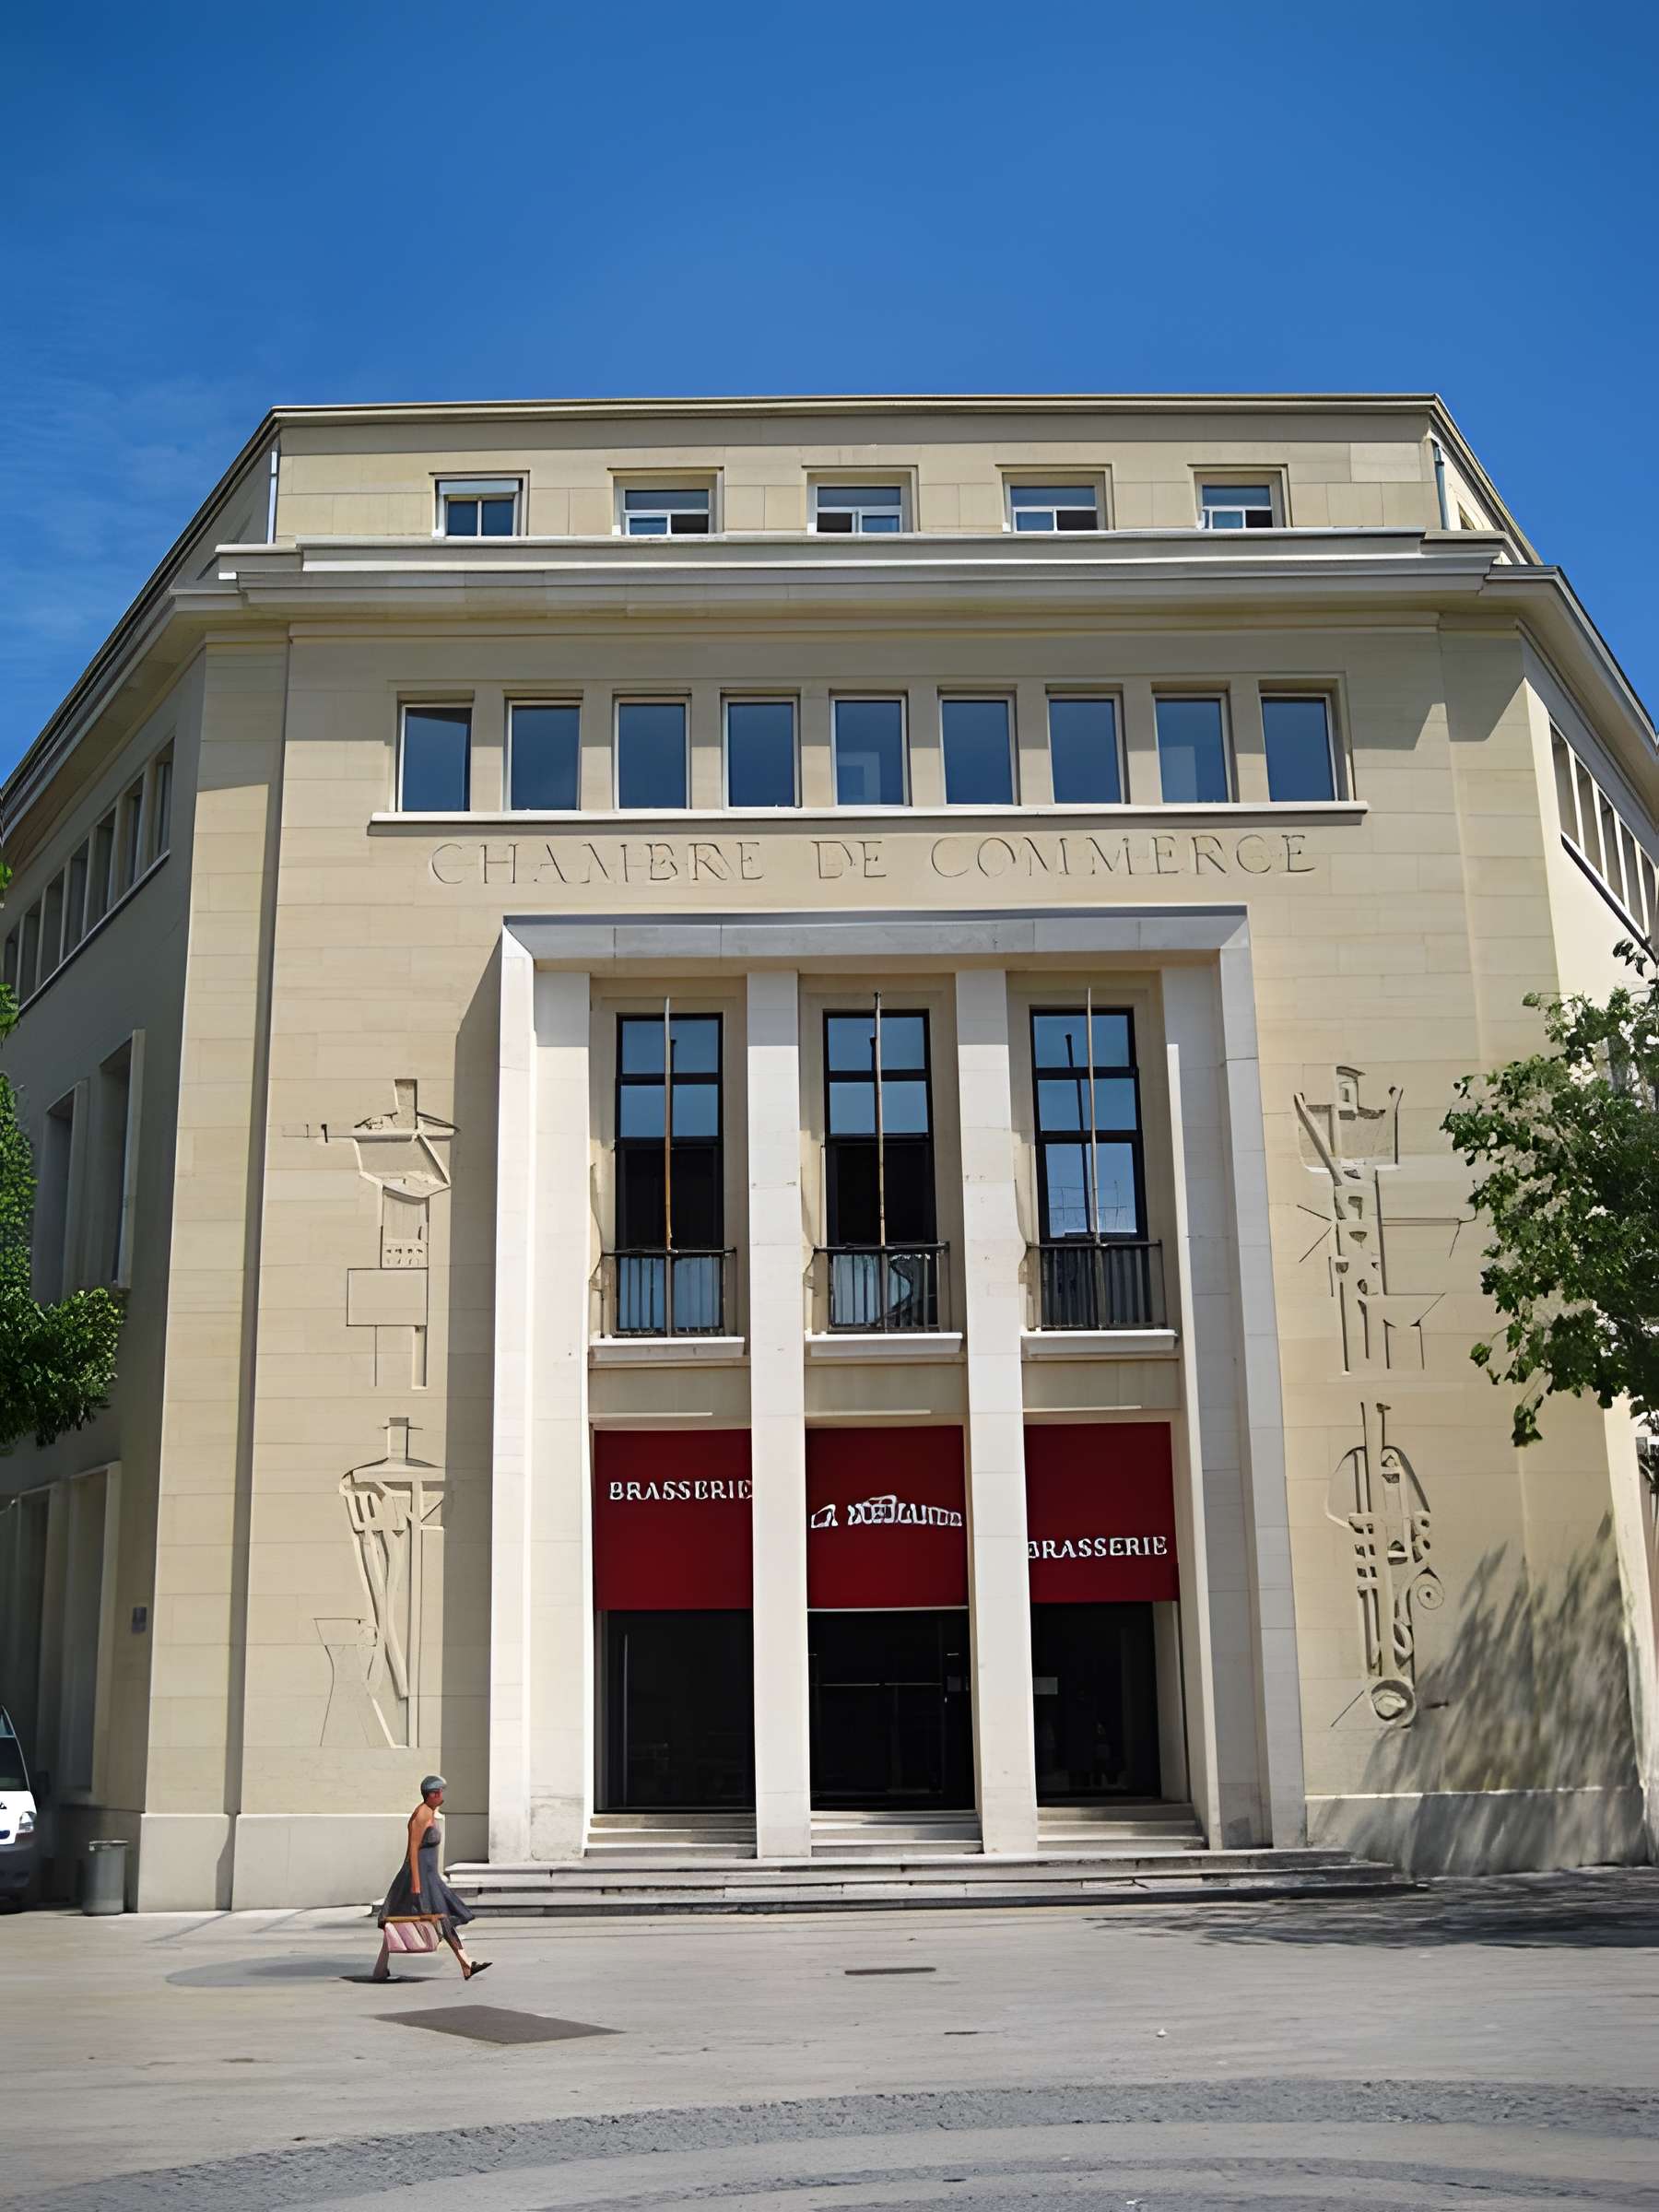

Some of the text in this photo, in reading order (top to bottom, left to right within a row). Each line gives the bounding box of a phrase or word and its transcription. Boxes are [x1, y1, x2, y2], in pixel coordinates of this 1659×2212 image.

[430, 834, 1315, 885] CHAMBRE DE COMMERCE
